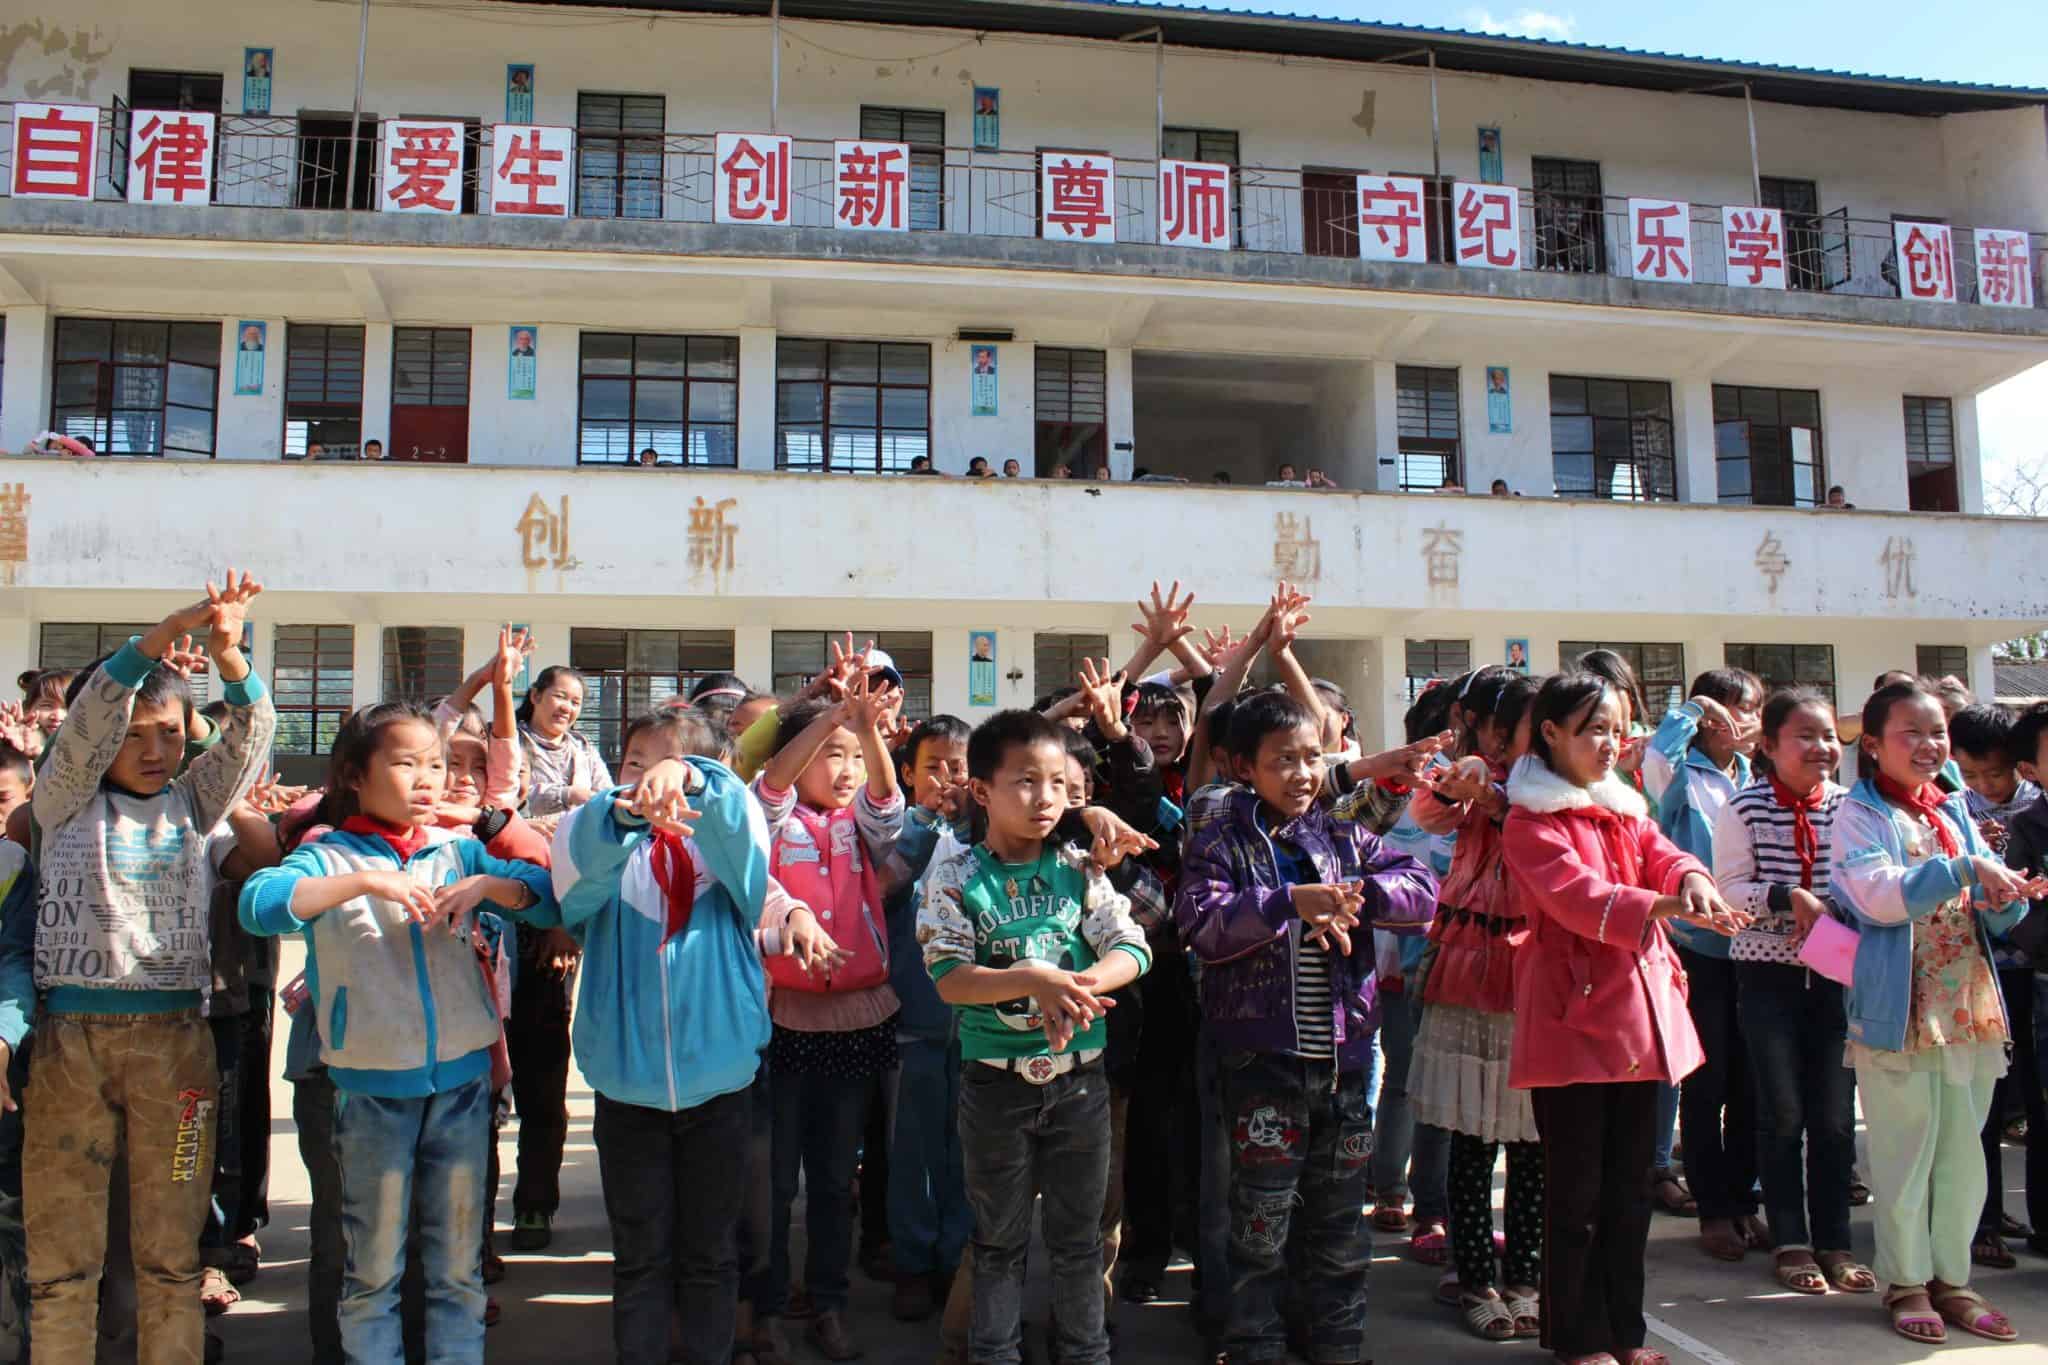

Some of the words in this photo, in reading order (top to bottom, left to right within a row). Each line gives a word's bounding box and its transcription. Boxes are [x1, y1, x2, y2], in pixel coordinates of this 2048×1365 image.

[15, 108, 93, 197] 自
[135, 115, 208, 200] 律
[387, 127, 459, 211] 爱
[495, 129, 565, 216] 生
[721, 138, 787, 219] 创
[839, 146, 905, 228] 新
[1047, 159, 1111, 238] 尊
[1163, 165, 1227, 244] 师
[1361, 182, 1421, 258] 守
[1459, 187, 1516, 267] 纪
[1636, 206, 1690, 280] 乐
[1728, 210, 1783, 285] 学
[1901, 227, 1951, 299] 创
[1979, 232, 2030, 307] 新
[514, 491, 568, 569] 创
